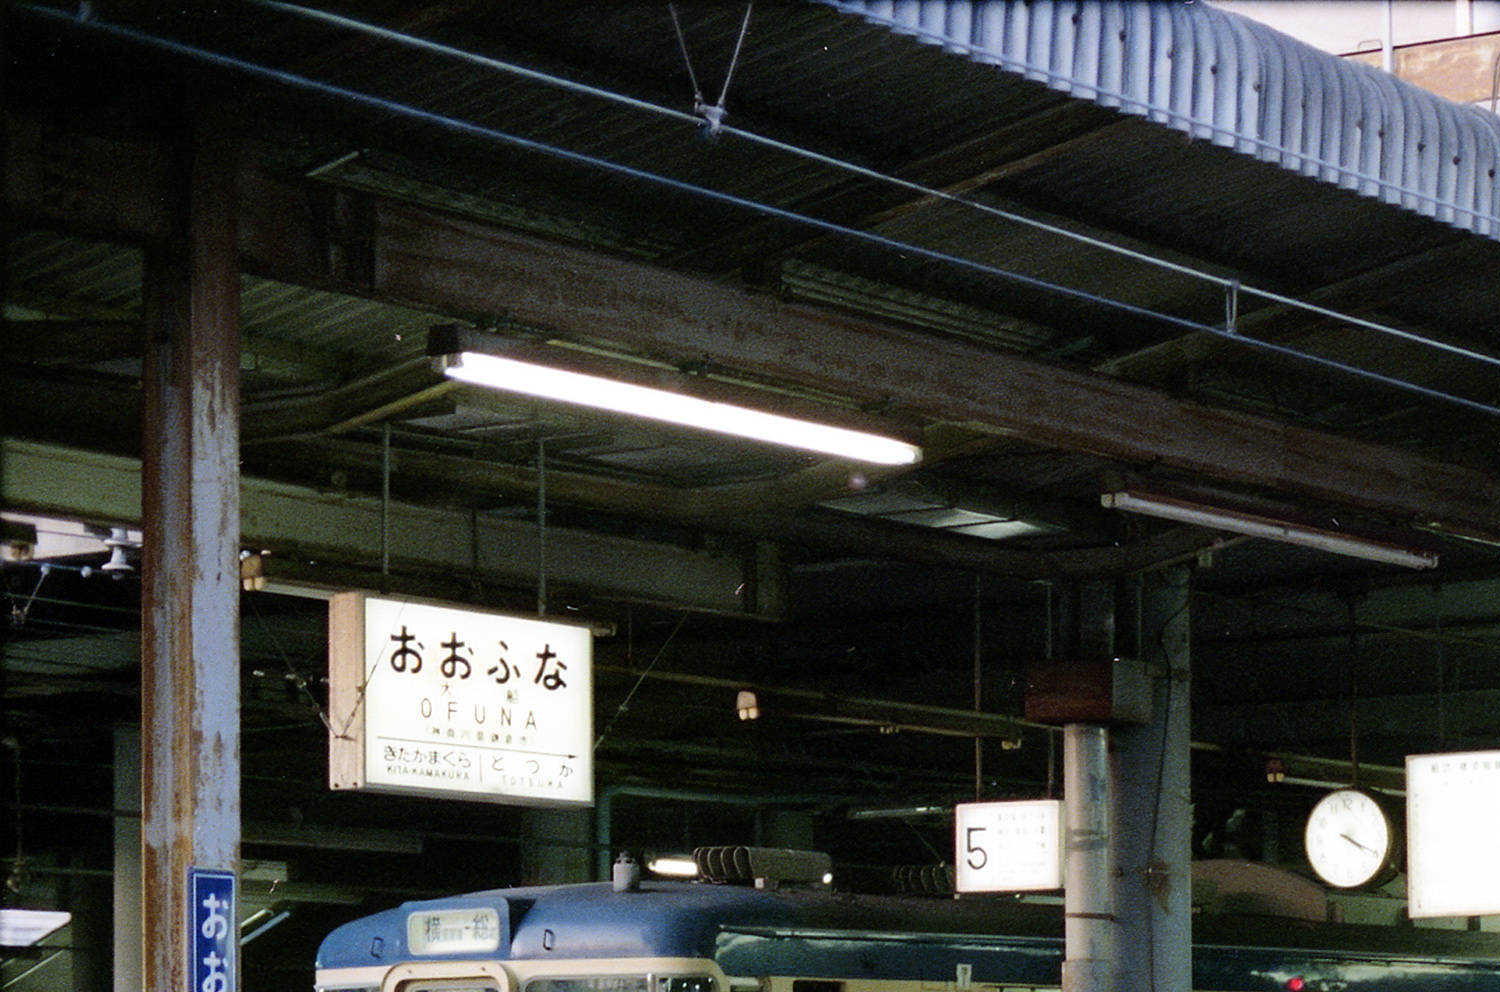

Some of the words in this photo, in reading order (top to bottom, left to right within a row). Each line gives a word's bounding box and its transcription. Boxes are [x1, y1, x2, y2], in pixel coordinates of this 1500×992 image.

[390, 625, 568, 691] おおふな
[440, 683, 519, 705] 大船
[420, 698, 537, 729] OFUNA
[383, 746, 471, 768] きたかまくら
[492, 756, 574, 779] とつか
[387, 765, 470, 781] KITA-KAMAKURA
[502, 774, 564, 790] TOTSUKA
[1341, 798, 1353, 811] 12
[966, 827, 988, 870] 5
